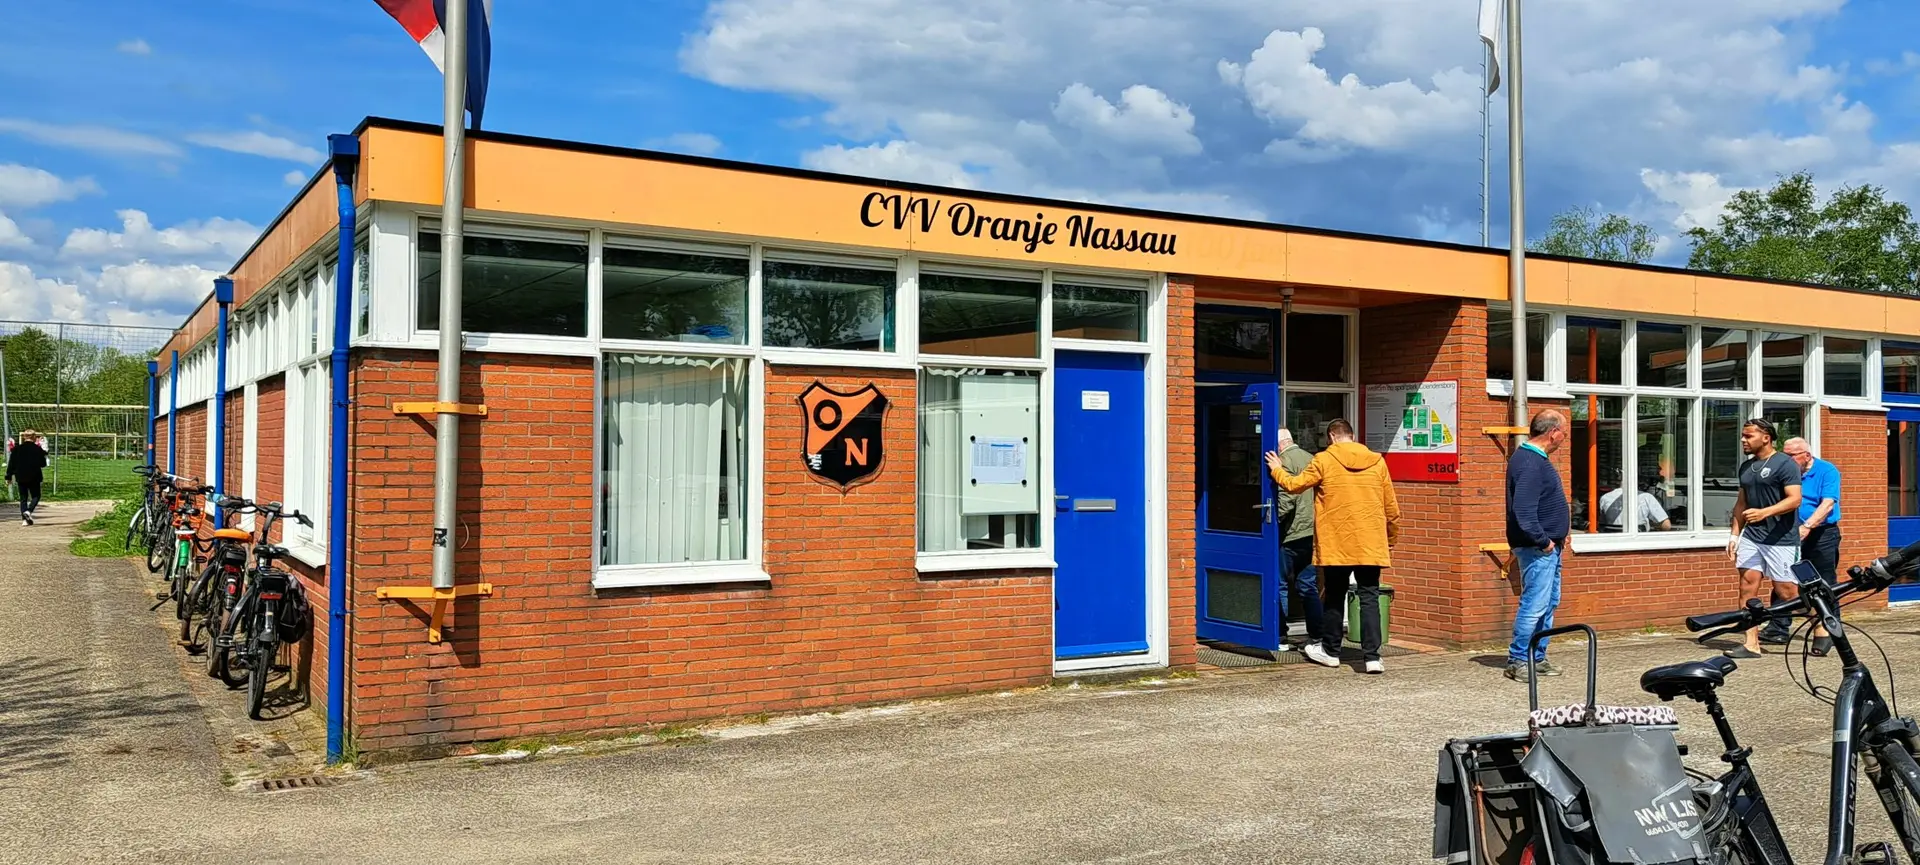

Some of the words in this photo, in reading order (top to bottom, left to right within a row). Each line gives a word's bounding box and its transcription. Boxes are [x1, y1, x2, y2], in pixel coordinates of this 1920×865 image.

[860, 191, 941, 233] CVV
[947, 202, 1058, 253] Oranje
[1065, 214, 1177, 256] Nassau
[814, 400, 842, 431] O
[845, 438, 868, 466] N
[1428, 462, 1455, 473] stad
